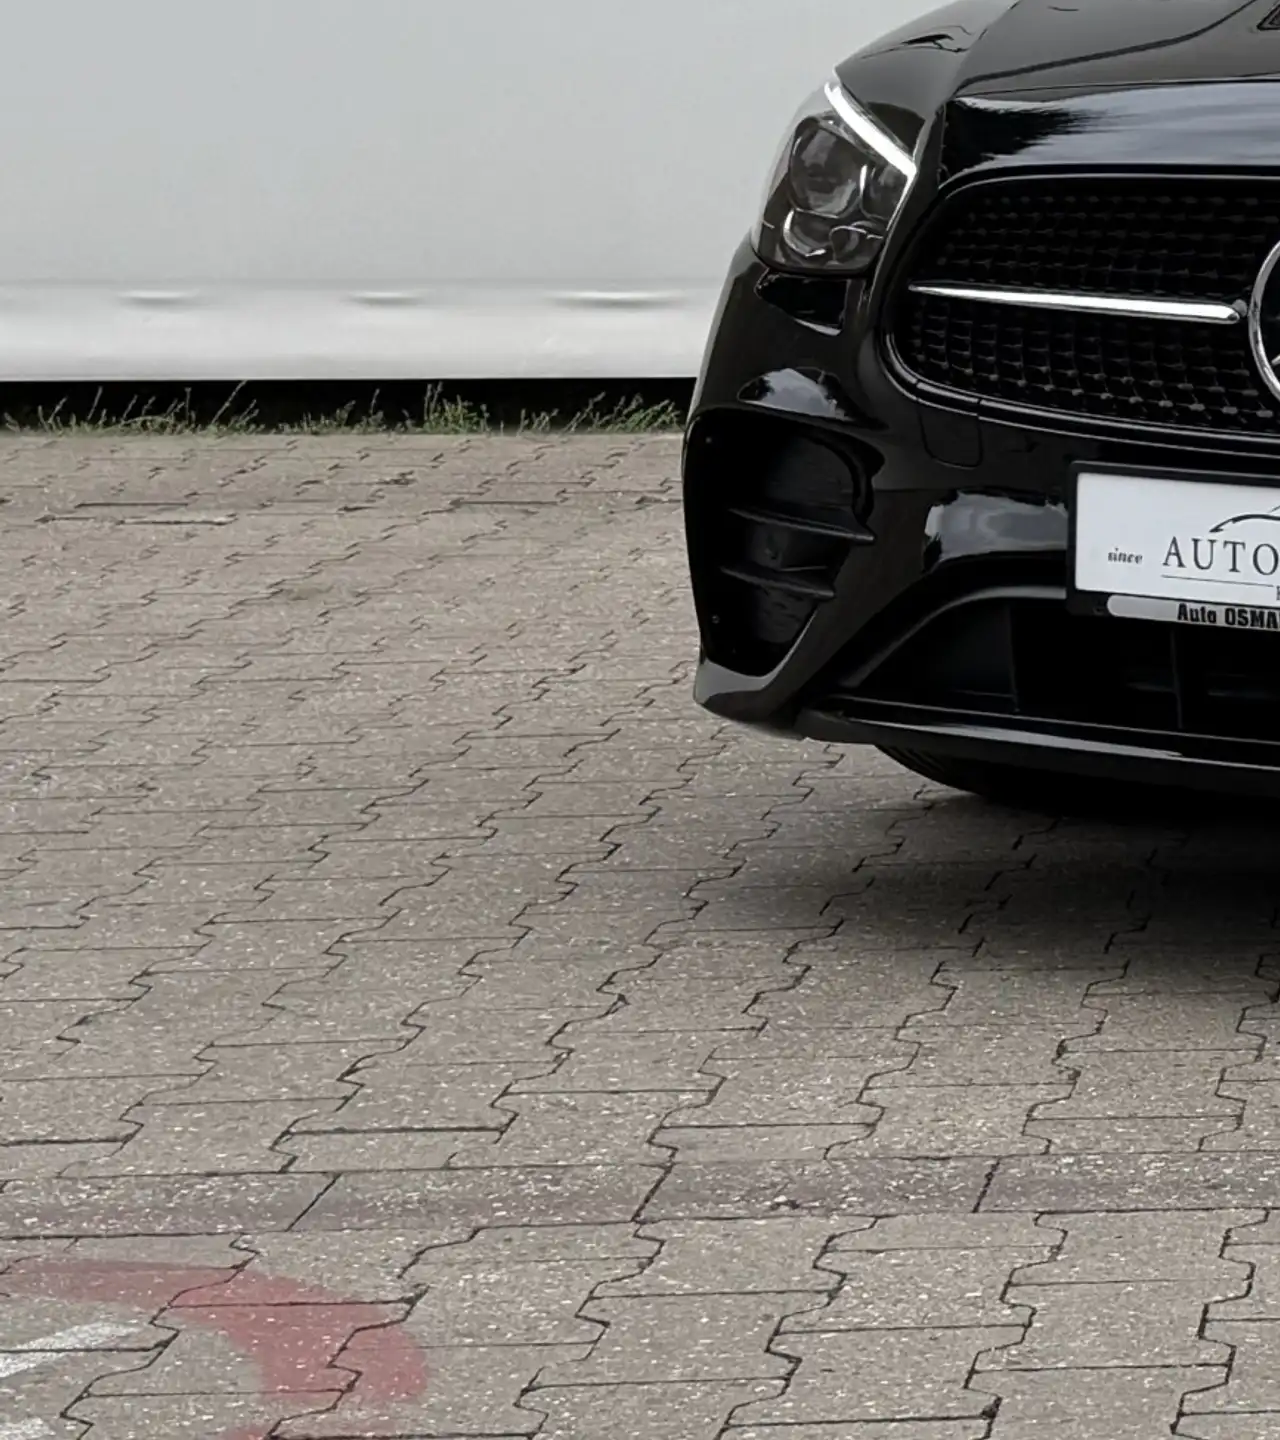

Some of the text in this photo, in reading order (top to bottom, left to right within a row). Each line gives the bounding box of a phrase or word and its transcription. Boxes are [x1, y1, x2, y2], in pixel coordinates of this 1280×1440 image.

[1107, 547, 1143, 564] since
[1162, 536, 1279, 575] AUTO
[1177, 603, 1216, 623] Auto
